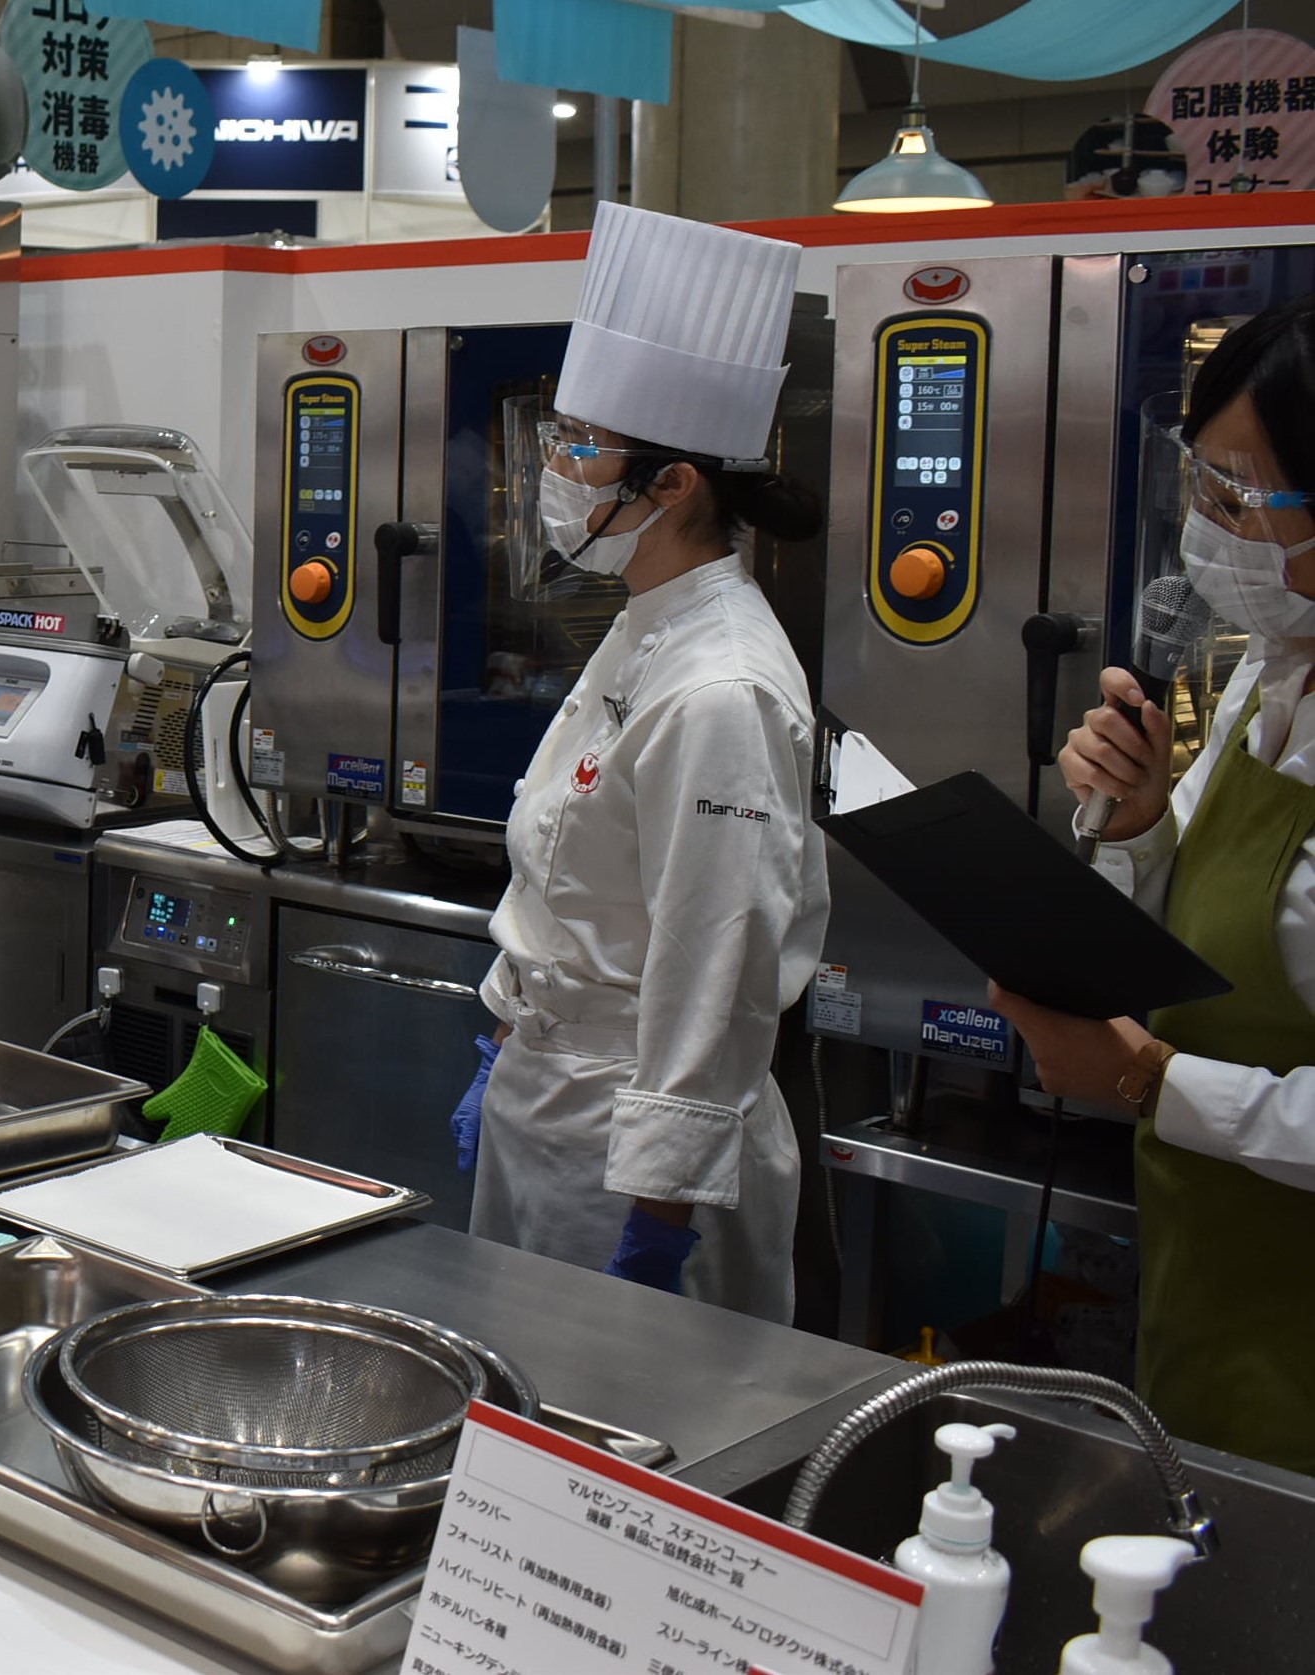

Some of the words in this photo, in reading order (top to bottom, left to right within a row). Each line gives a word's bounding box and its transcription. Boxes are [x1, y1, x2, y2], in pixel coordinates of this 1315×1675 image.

[42, 31, 110, 81] 対策
[41, 90, 110, 141] 消毒
[1172, 77, 1315, 120] 配膳機器
[53, 141, 100, 174] 機器
[1207, 125, 1280, 163] 体験
[897, 339, 930, 353] Super
[932, 338, 967, 350] Steam
[35, 614, 62, 631] HOT
[696, 799, 770, 824] Maruzen
[922, 1022, 1004, 1052] Maruzen
[567, 1478, 655, 1528] マルゼンブース
[666, 1521, 778, 1576] スチコンコーナー
